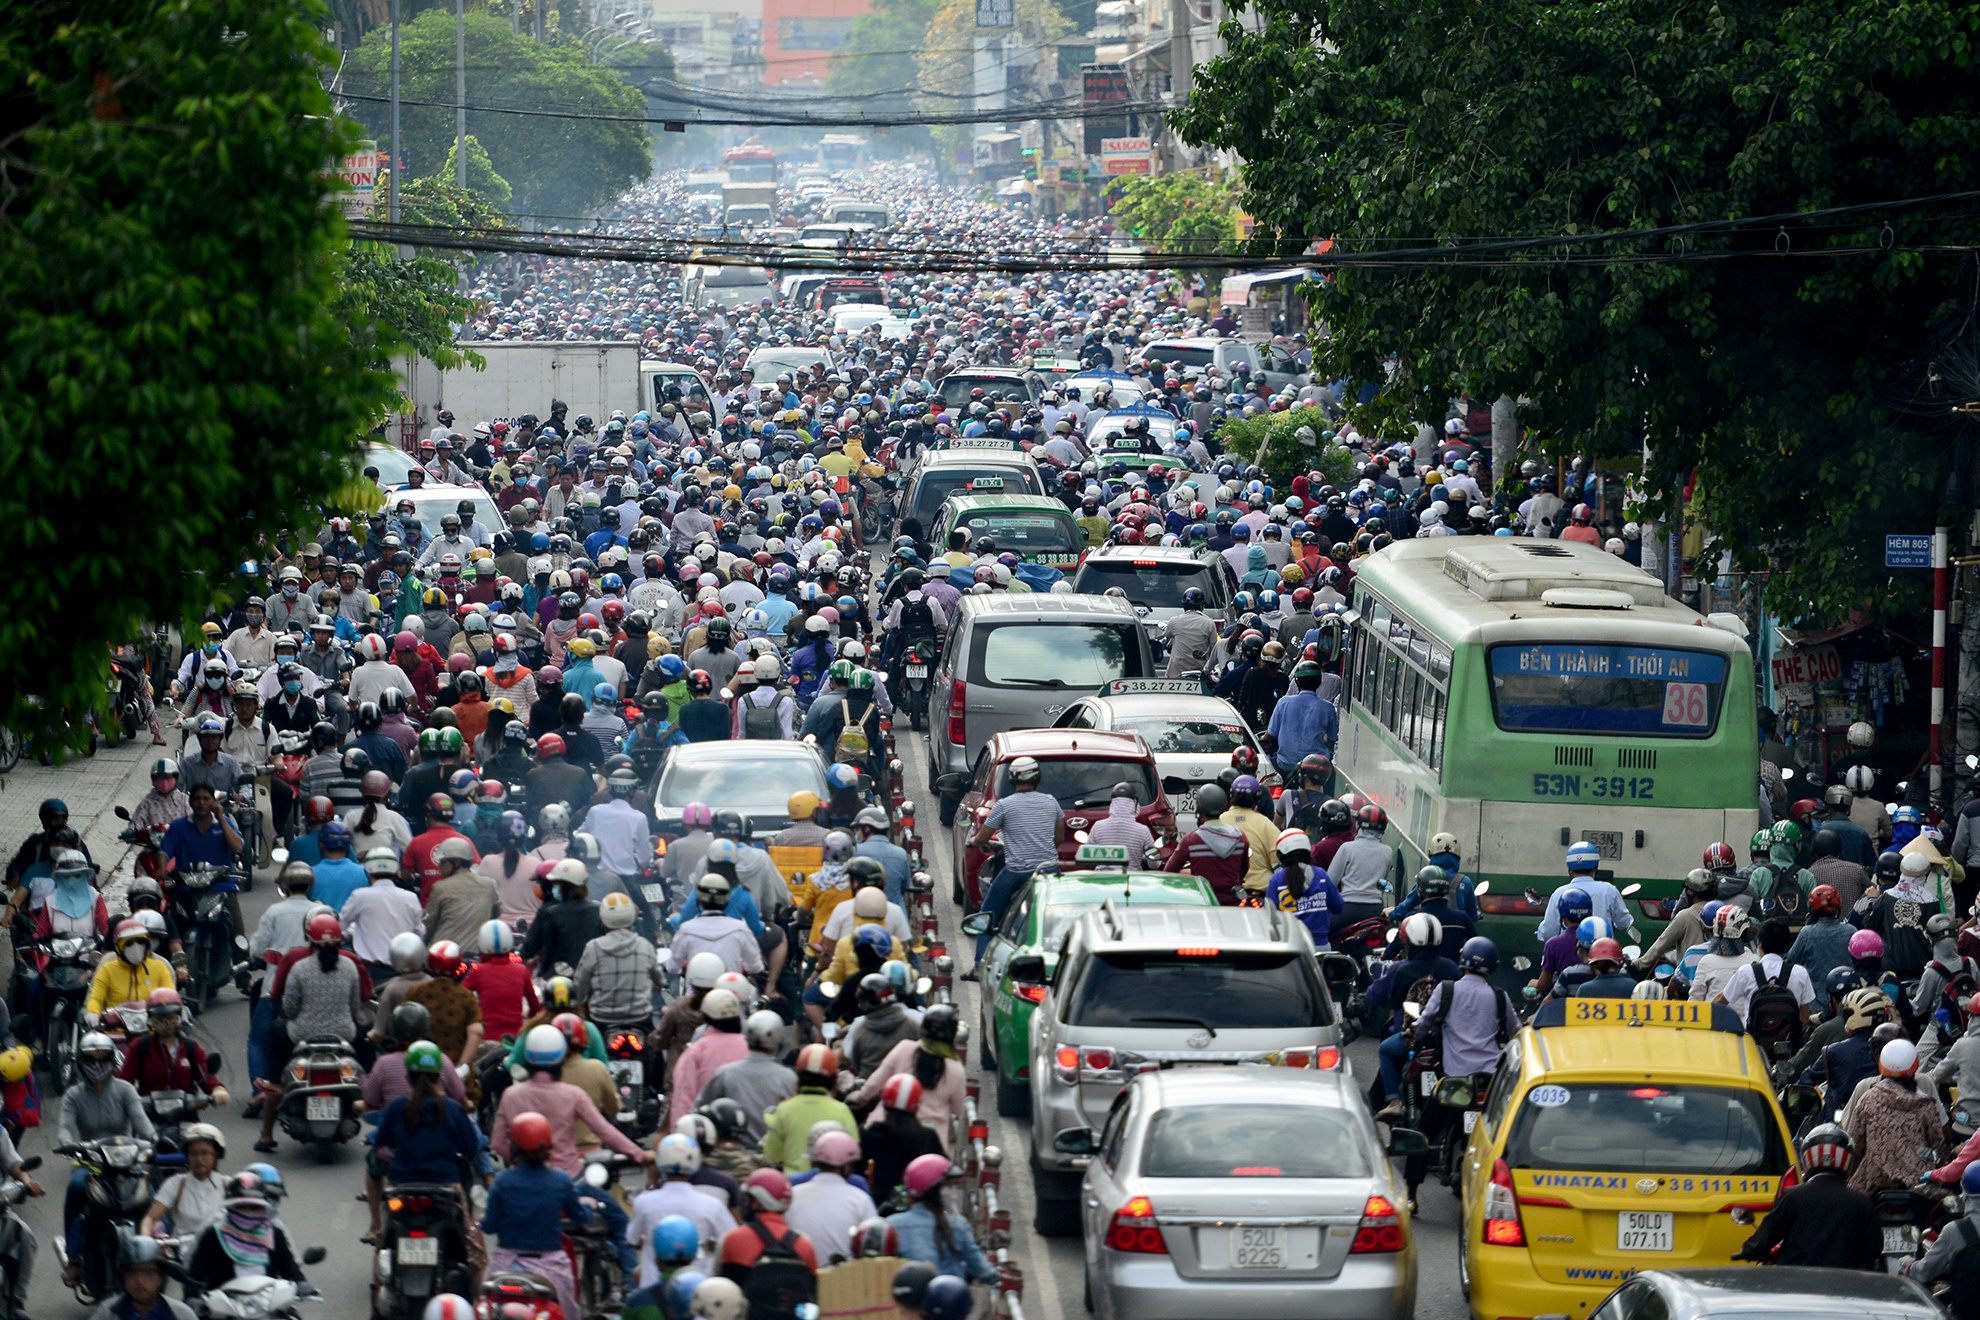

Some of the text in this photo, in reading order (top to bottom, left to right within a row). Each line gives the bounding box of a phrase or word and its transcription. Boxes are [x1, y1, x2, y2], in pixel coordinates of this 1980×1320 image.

[1912, 539, 1928, 549] 805
[1037, 554, 1046, 564] 38
[1048, 554, 1057, 563] 38
[1059, 554, 1068, 563] 38
[1069, 554, 1078, 563] 38
[1519, 645, 1551, 671] BẾN
[1558, 649, 1610, 673] THÀNH
[1668, 658, 1689, 677] AN
[1132, 682, 1199, 691] 38.27 27 27
[1667, 684, 1704, 724] 36
[1576, 1002, 1701, 1022] 38 111 111
[1533, 1089, 1566, 1099] 6035
[1533, 1174, 1770, 1193] VINATAXI 38 111 111
[1629, 1213, 1662, 1230] 50LD
[1243, 1229, 1276, 1247] 52U
[1623, 1231, 1667, 1248] 077.11
[1237, 1248, 1281, 1265] 8225
